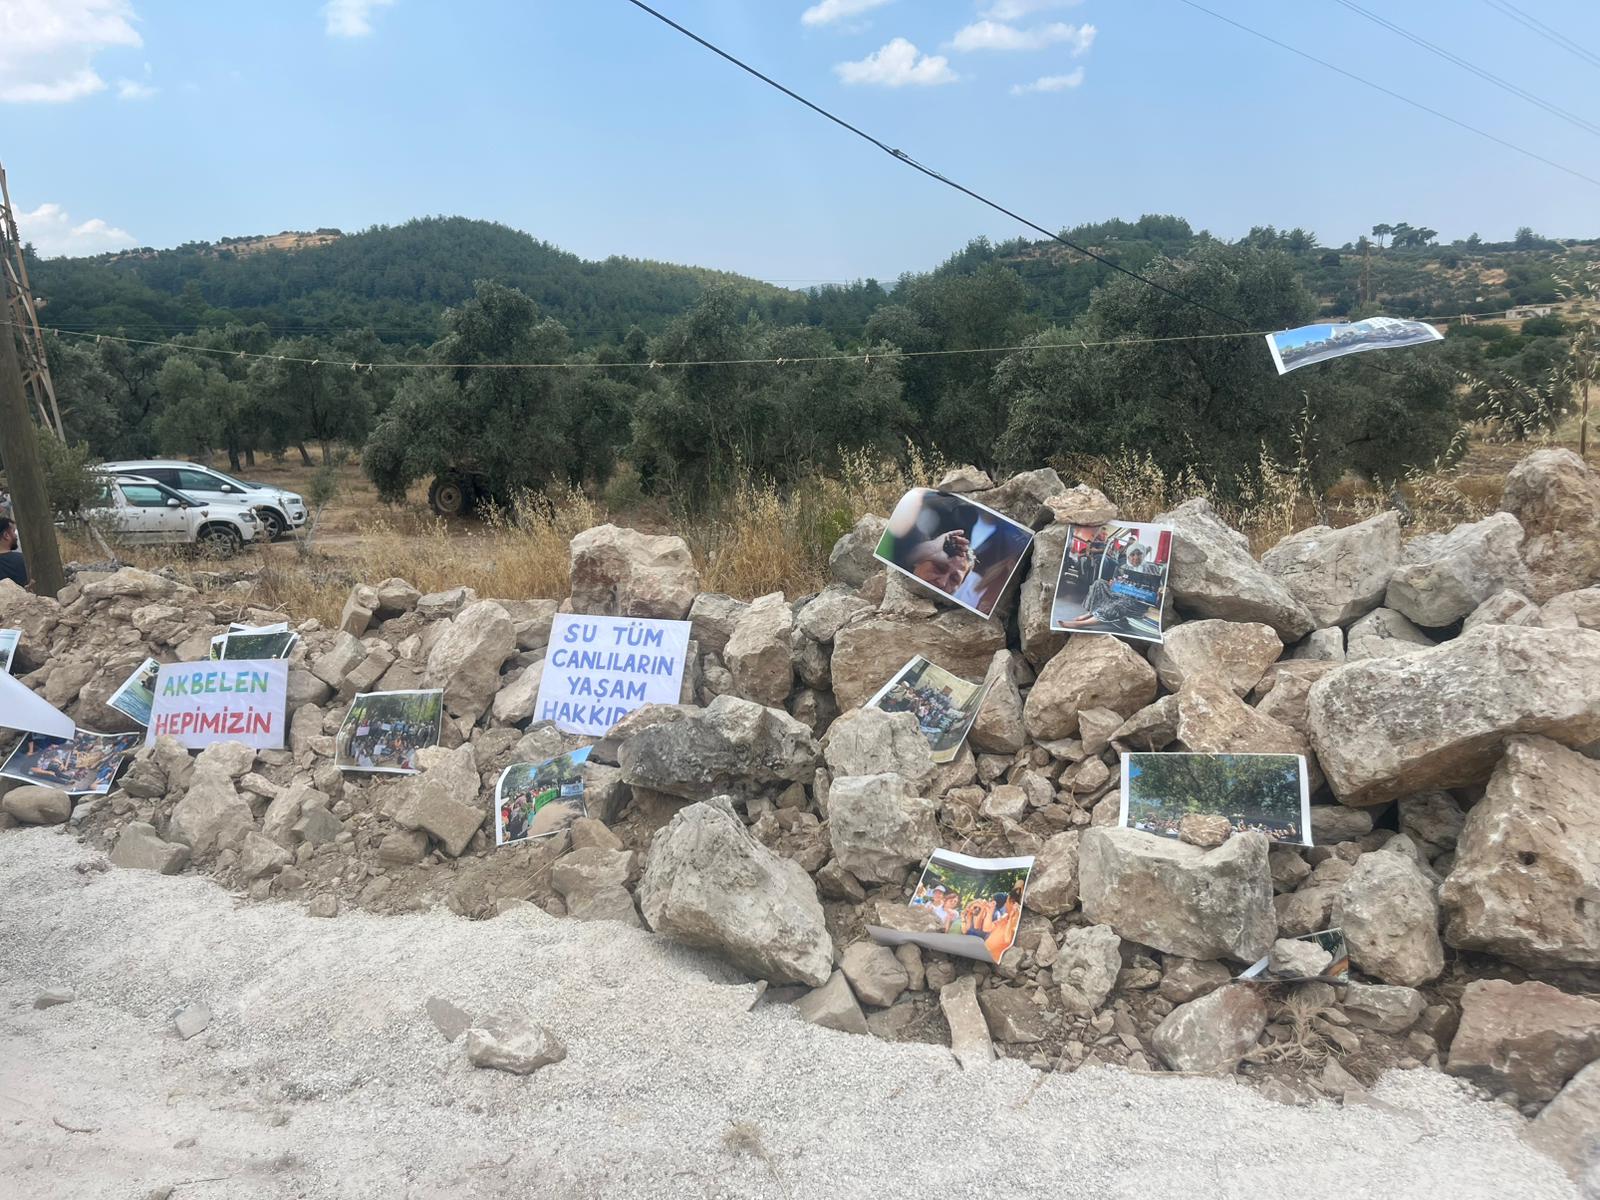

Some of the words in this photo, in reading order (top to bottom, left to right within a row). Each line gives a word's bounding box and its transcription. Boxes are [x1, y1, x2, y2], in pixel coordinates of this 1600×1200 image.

[563, 623, 598, 643] SU
[613, 621, 664, 647] TÜM
[552, 648, 675, 676] CANLILARIN
[162, 671, 269, 697] AKBELEN
[567, 676, 647, 703] YAŞAM
[155, 706, 272, 736] HEPİMİZİN
